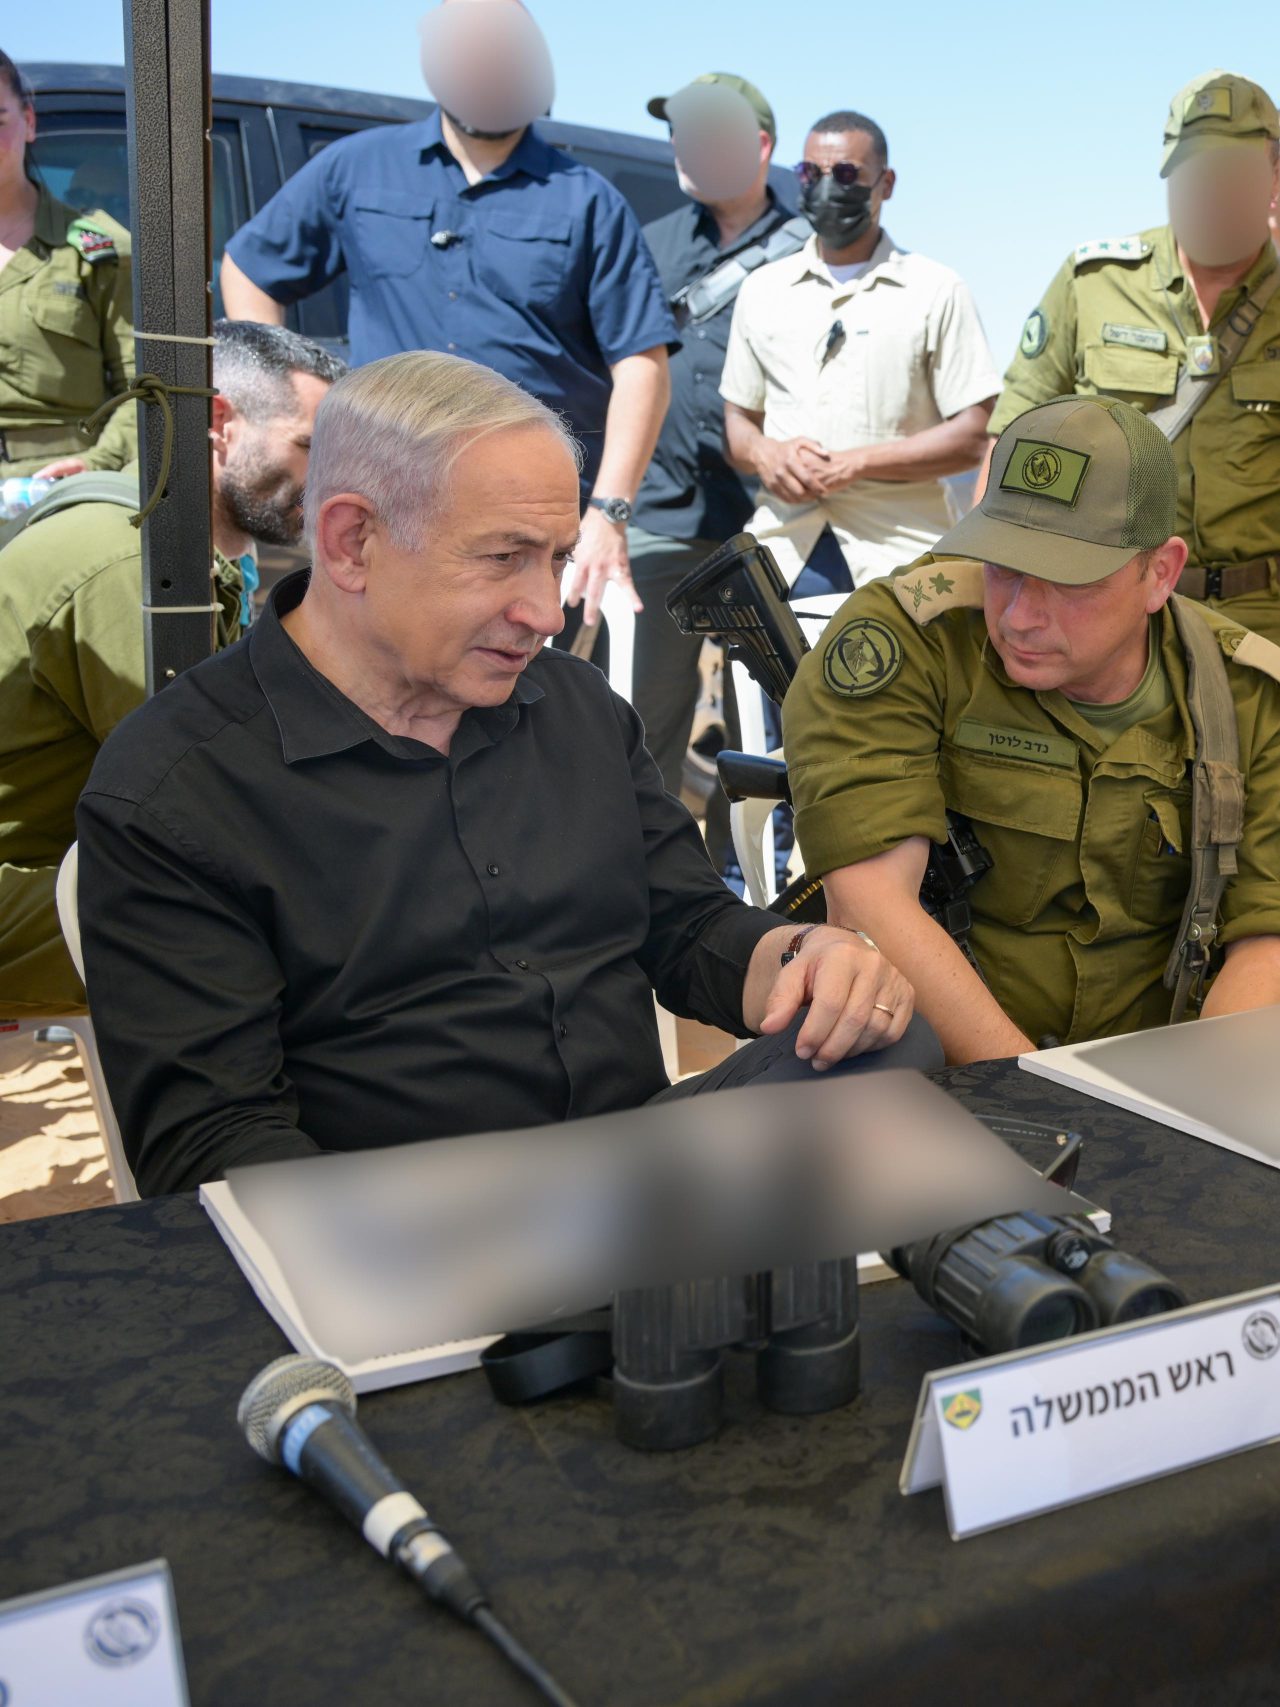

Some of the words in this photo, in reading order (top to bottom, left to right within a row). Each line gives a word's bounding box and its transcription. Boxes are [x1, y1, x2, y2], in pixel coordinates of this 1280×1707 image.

[989, 733, 1022, 747] לוטן
[1024, 740, 1049, 754] נדב
[1167, 1350, 1237, 1393] ראש
[1009, 1369, 1161, 1438] הממשלה
